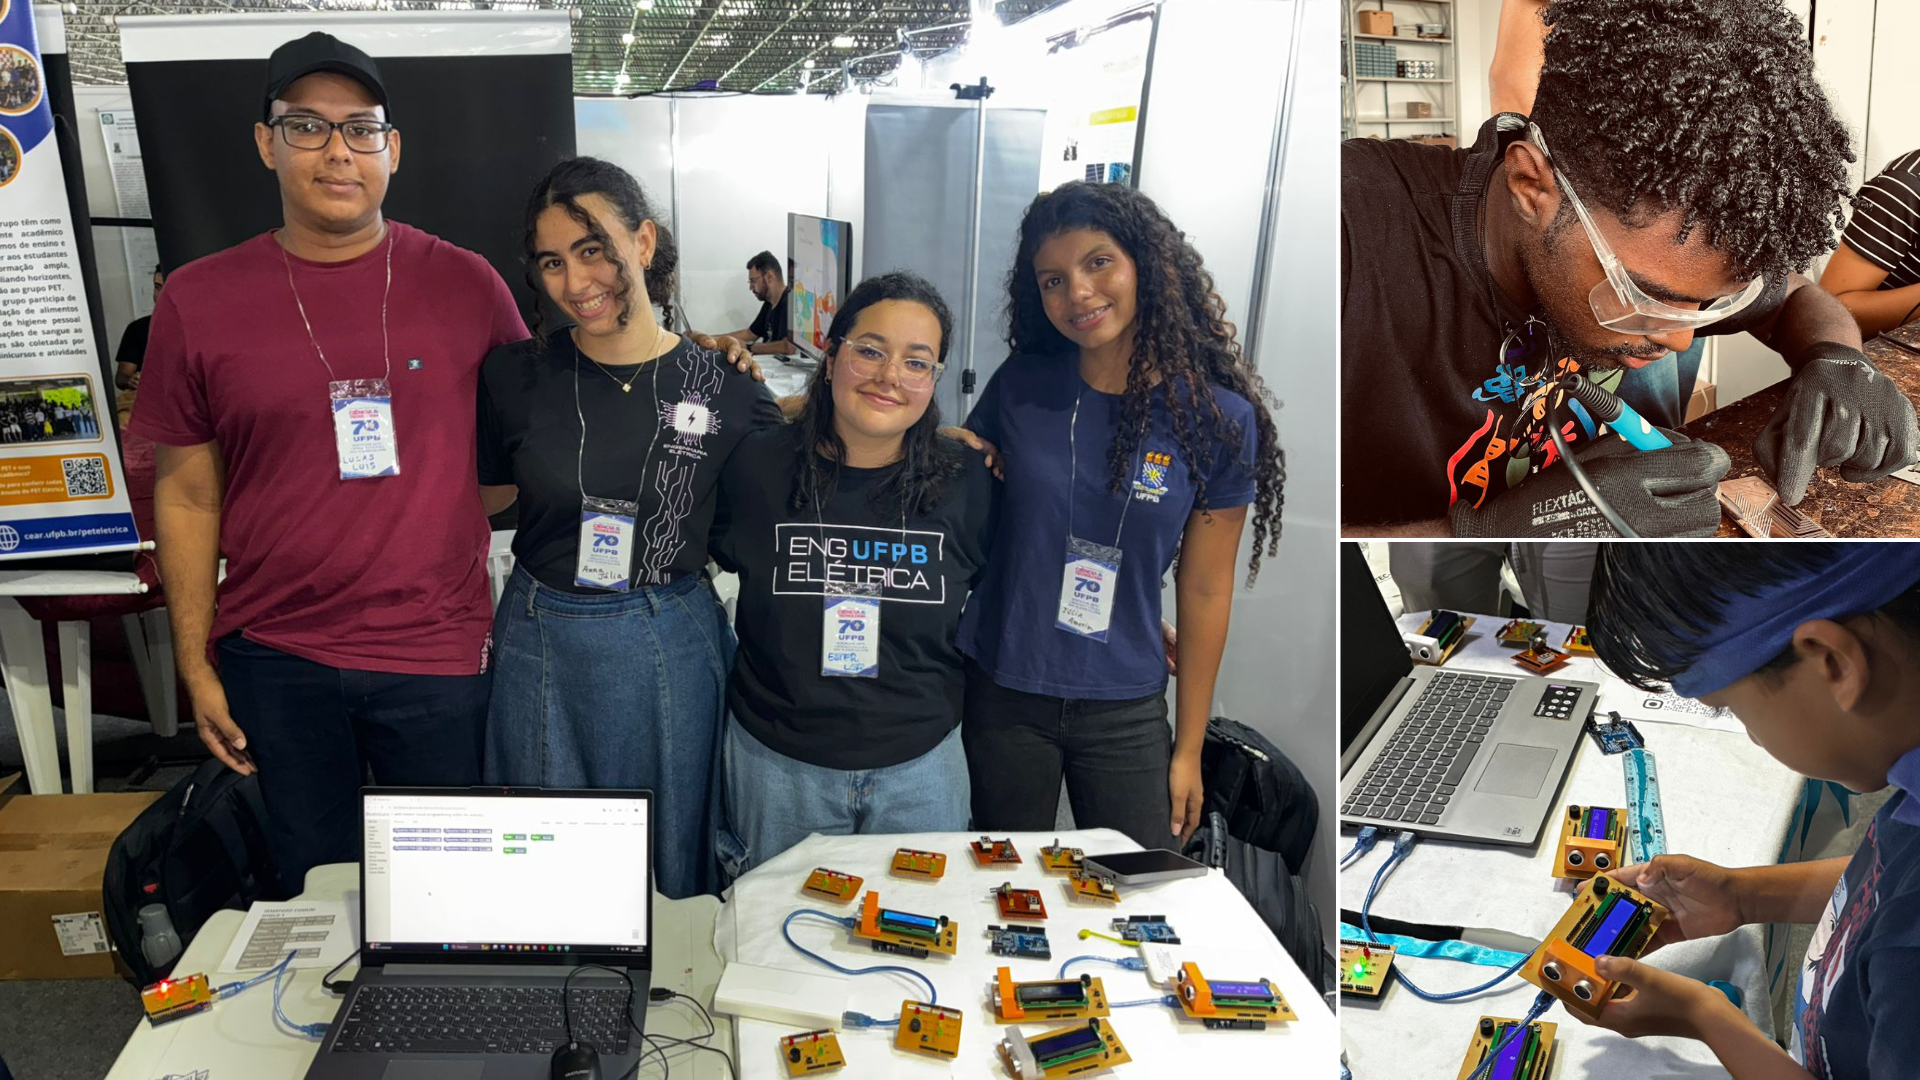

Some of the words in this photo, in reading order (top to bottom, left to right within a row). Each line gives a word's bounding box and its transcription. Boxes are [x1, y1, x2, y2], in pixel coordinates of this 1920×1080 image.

[21, 218, 38, 226] têm
[21, 229, 63, 237] acadêmico
[32, 240, 59, 248] ensino
[23, 251, 68, 259] estudantes
[43, 261, 70, 270] ampla,
[28, 273, 72, 281] horizontes,
[22, 286, 46, 294] grupo
[29, 296, 65, 305] participa
[25, 307, 35, 315] de
[40, 306, 78, 314] alimentos
[17, 318, 47, 327] higiene
[52, 316, 81, 325] pessoal
[42, 328, 70, 336] sangue
[29, 338, 68, 347] coletadas
[72, 338, 84, 346] por
[47, 348, 87, 357] atividades
[1136, 491, 1160, 503] UFPB
[1532, 489, 1591, 517] FLEXTÁC
[24, 525, 129, 540] cear.ufpb.br/peteletrica
[592, 533, 619, 547] 70
[592, 547, 618, 556] UFPB
[790, 536, 848, 558] ENG
[853, 539, 929, 565] UFPB
[788, 560, 931, 591] ELÉTRICA
[1074, 576, 1101, 593] 70
[1073, 591, 1100, 603] UFPB
[838, 619, 865, 634] 70
